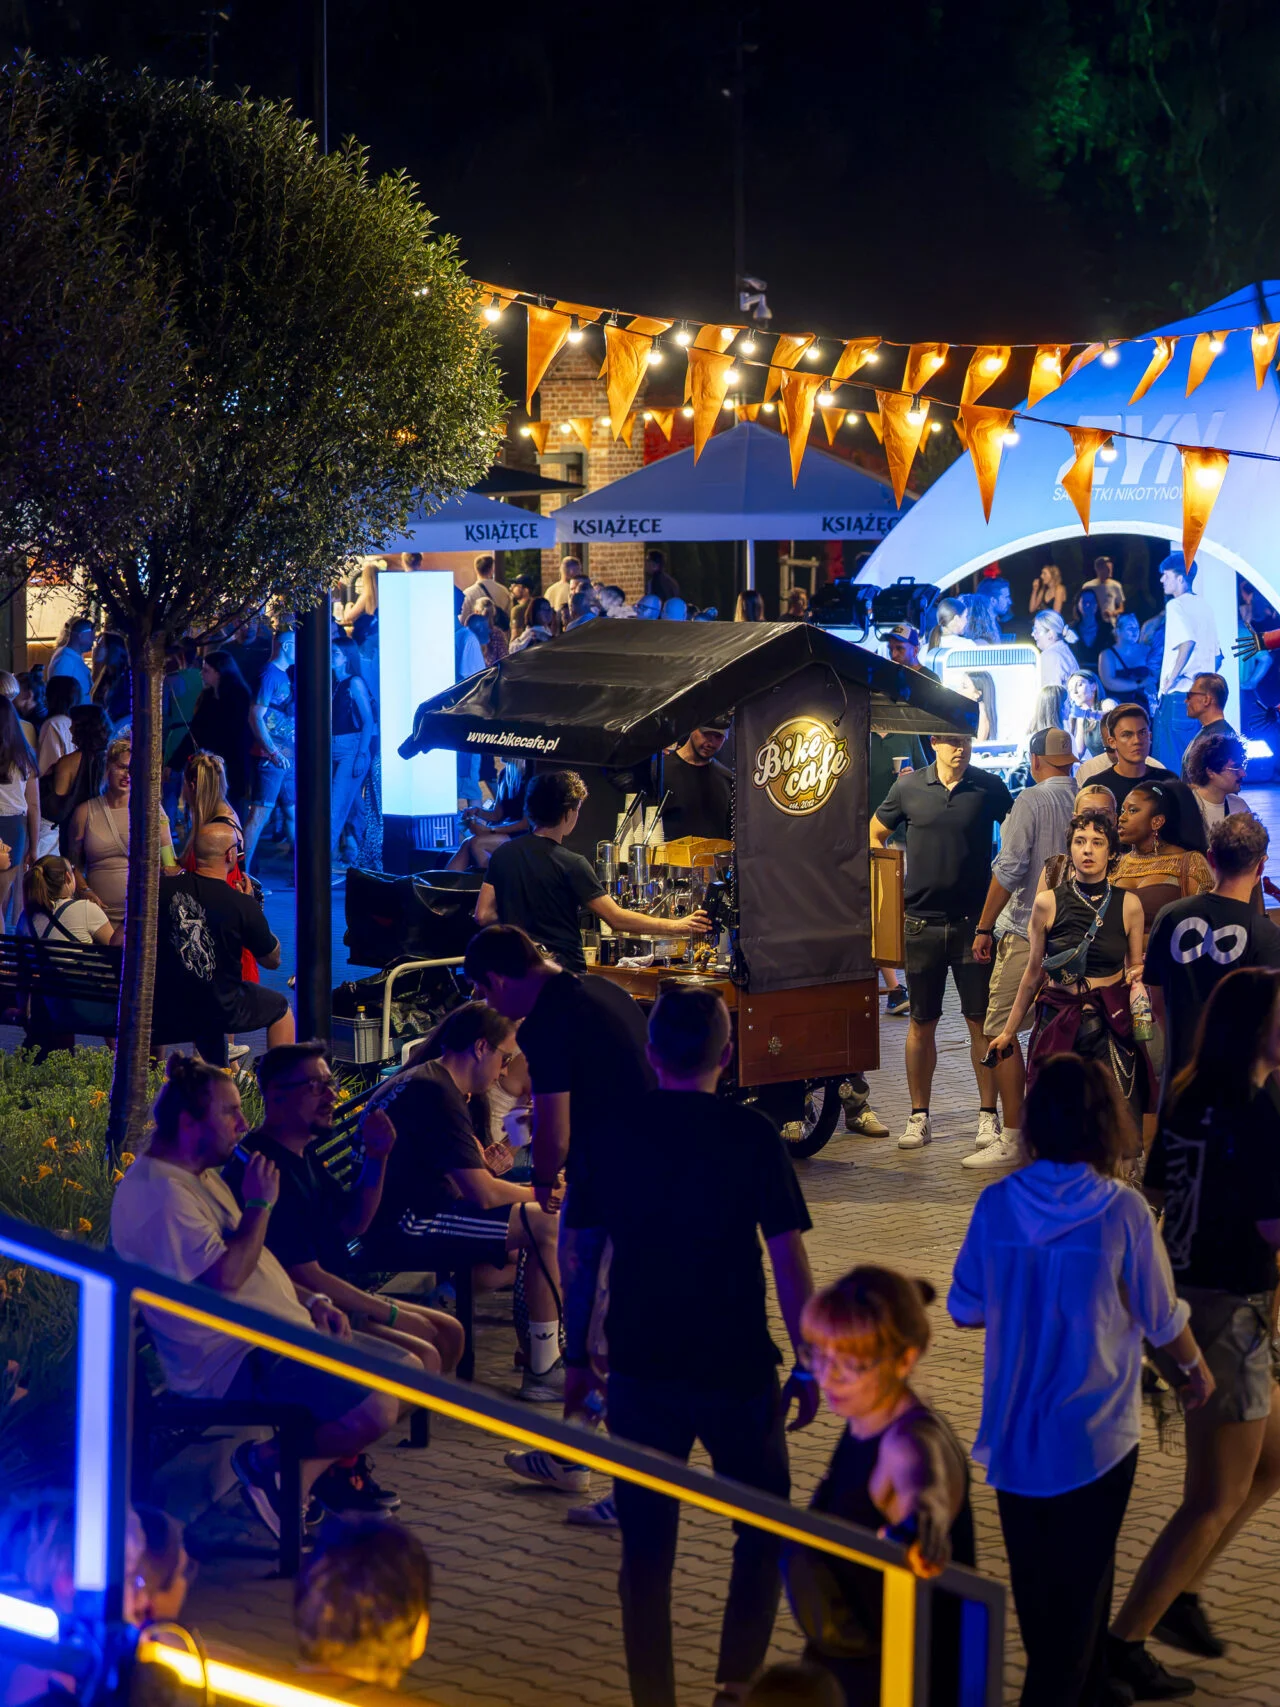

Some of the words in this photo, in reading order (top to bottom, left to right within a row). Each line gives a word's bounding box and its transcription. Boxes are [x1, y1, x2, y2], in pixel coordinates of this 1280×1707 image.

[1053, 487, 1113, 501] SATKI
[1114, 486, 1183, 501] NIKOTYNO
[465, 520, 538, 543] KSIĄŻĘCE
[573, 515, 662, 538] KSIĄŻĘCE
[822, 513, 900, 535] KSIĄŻĘC
[466, 731, 560, 754] www.bikecafe.pl
[753, 733, 823, 786] Bike
